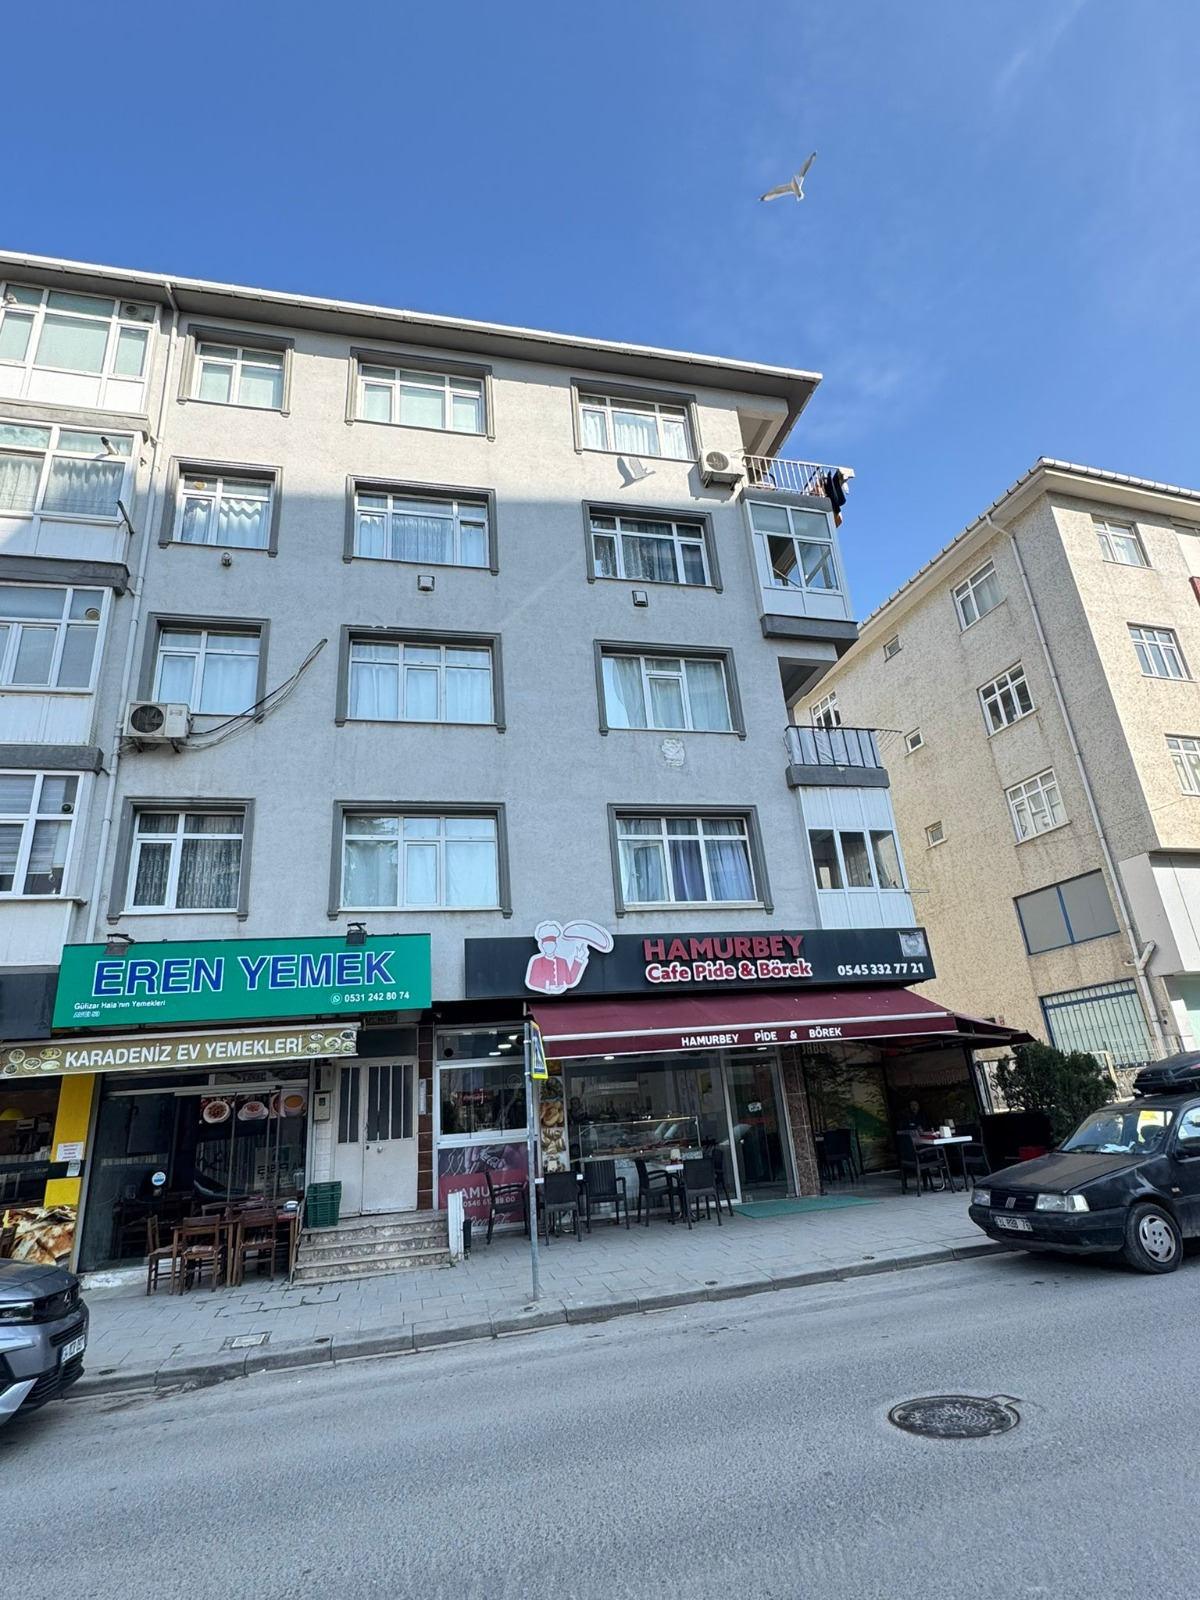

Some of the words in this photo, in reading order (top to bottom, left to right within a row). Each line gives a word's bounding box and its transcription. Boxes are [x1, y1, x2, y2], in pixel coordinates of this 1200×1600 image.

[643, 935, 804, 961] HAMURBEY
[92, 957, 225, 997] EREN
[237, 951, 396, 991] YEMEK
[645, 962, 691, 983] Cafe
[693, 960, 737, 982] Pide
[738, 961, 757, 980] &
[757, 958, 813, 979] Börek
[837, 964, 869, 976] 0545
[870, 963, 892, 975] 332
[894, 963, 908, 974] 77
[910, 963, 925, 974] 21
[132, 1000, 166, 1008] Yemekleri
[344, 993, 365, 1003] 0531
[368, 992, 384, 1002] 242
[386, 991, 397, 1001] 80
[399, 991, 409, 1000] 74
[681, 1033, 739, 1047] HAMURBEY
[754, 1029, 778, 1042] PİDE
[789, 1030, 798, 1040] &
[808, 1026, 842, 1039] BÖREK
[65, 1043, 172, 1068] KARADENİZ
[177, 1043, 201, 1061] EV
[205, 1035, 303, 1059] YEMEKLERİ
[505, 1195, 516, 1203] 00
